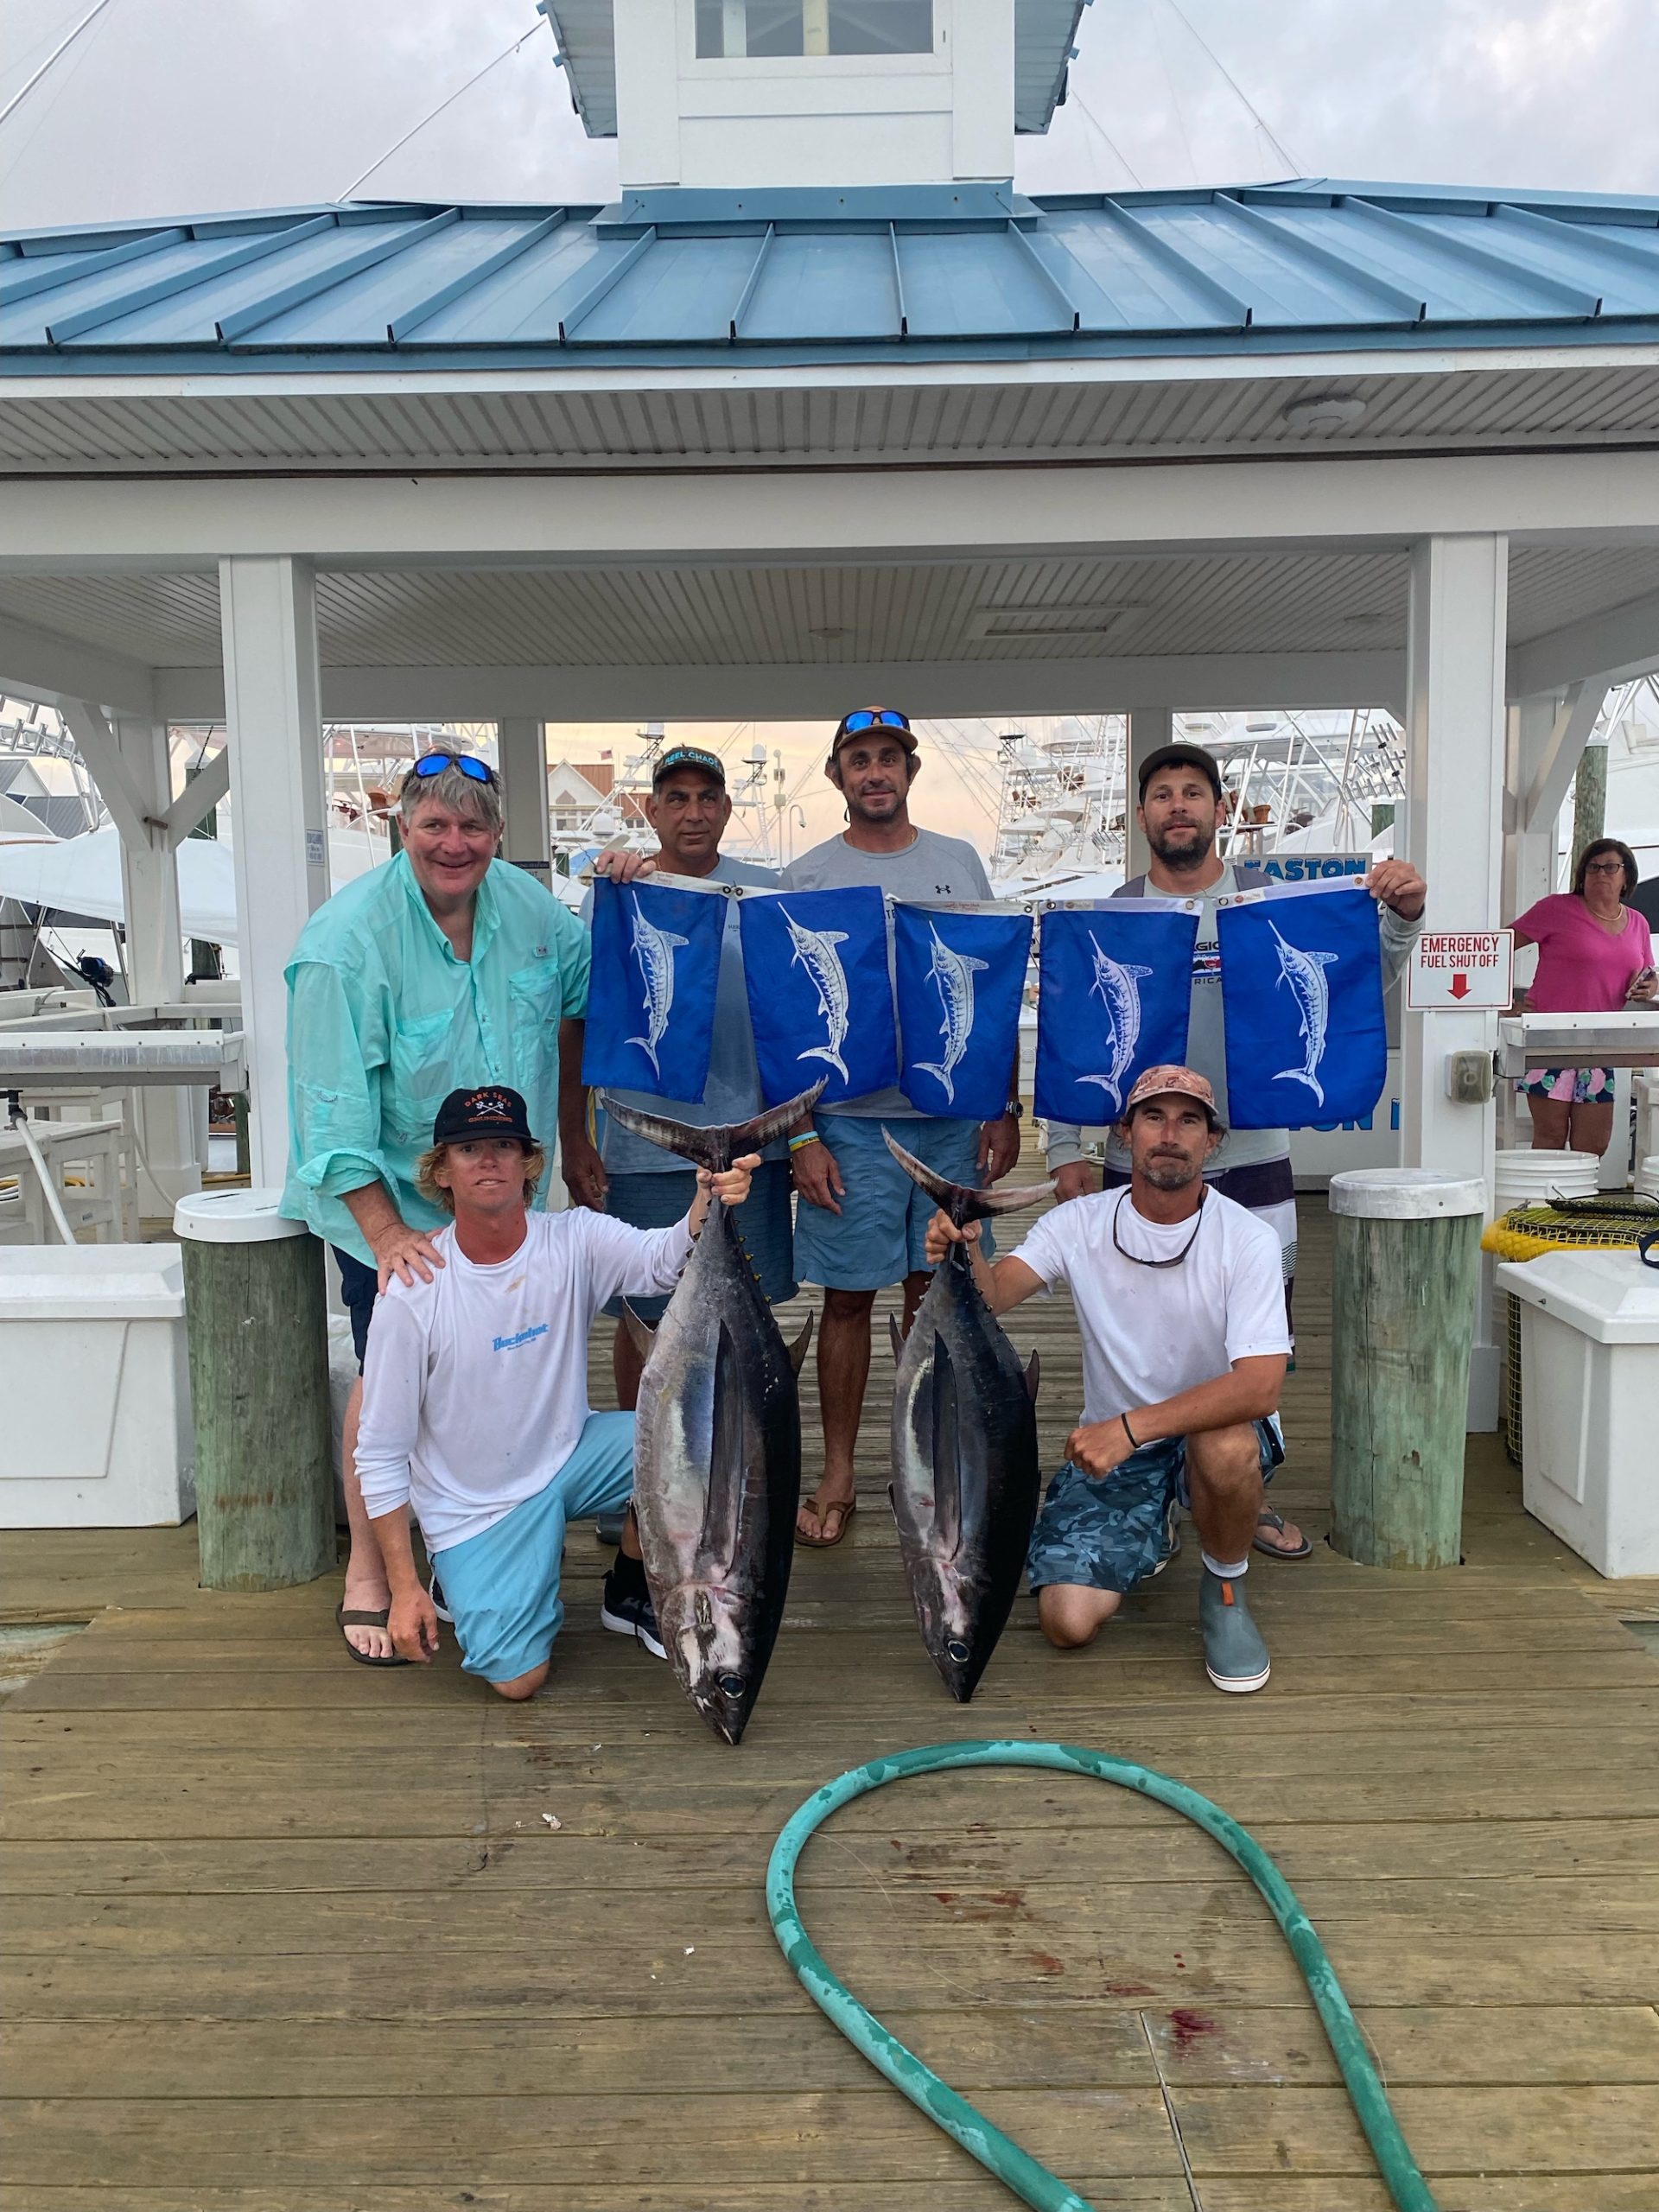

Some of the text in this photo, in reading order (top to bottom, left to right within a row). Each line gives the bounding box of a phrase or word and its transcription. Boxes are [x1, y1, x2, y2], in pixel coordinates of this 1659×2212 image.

[1421, 937, 1499, 952] EMERGENCY
[1421, 954, 1499, 968] FUEL SHUT OFF
[464, 1091, 489, 1107] DARK
